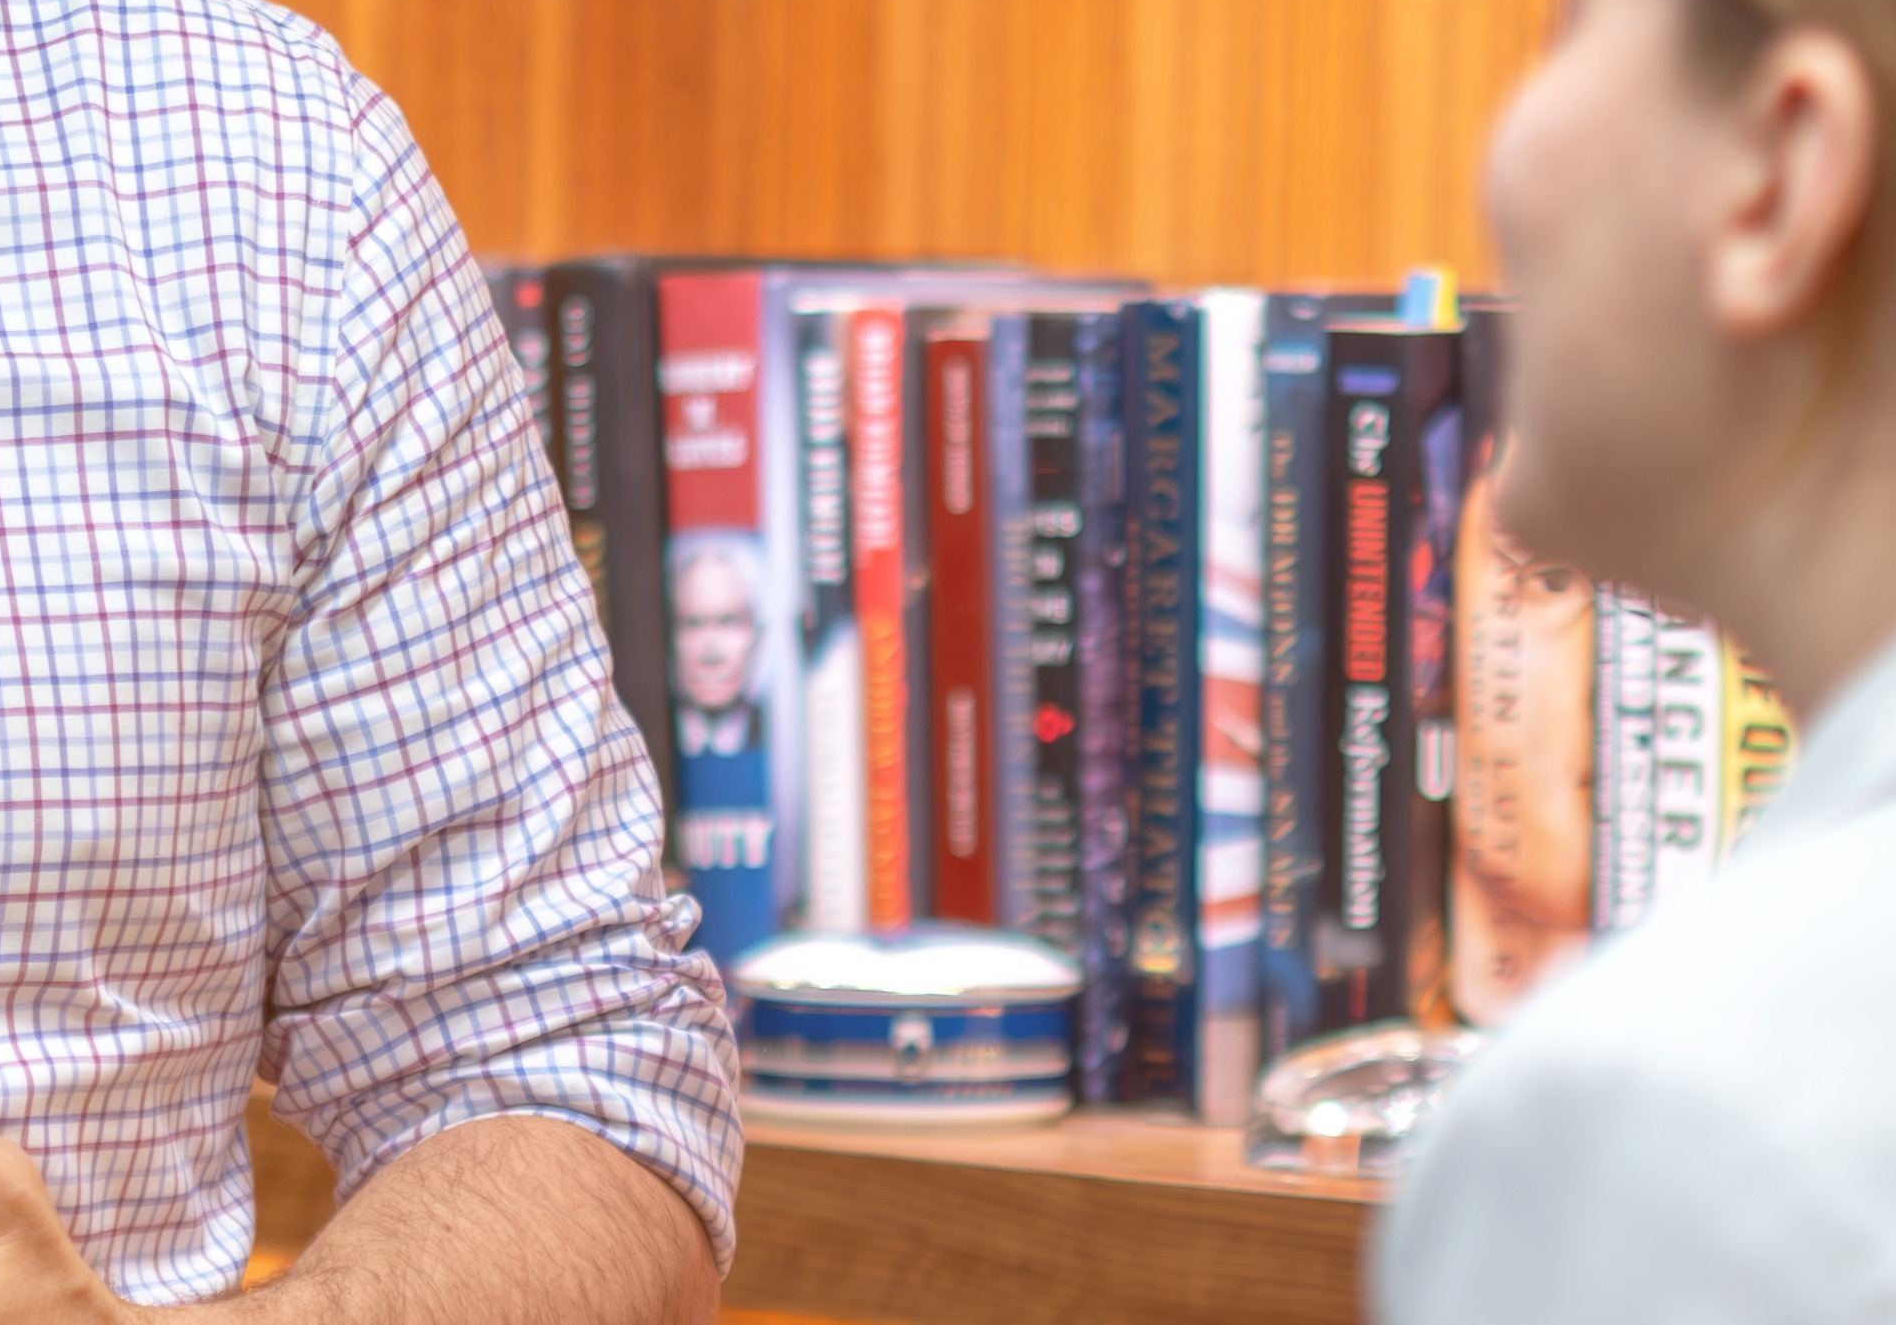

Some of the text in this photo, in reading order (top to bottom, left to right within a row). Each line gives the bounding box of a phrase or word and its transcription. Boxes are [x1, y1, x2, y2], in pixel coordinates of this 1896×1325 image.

[1141, 332, 1182, 703] MARGARET
[1348, 400, 1391, 477] The
[1344, 479, 1388, 682] UNINTENDED
[681, 813, 772, 869] UTY
[1339, 684, 1391, 931] Reformation
